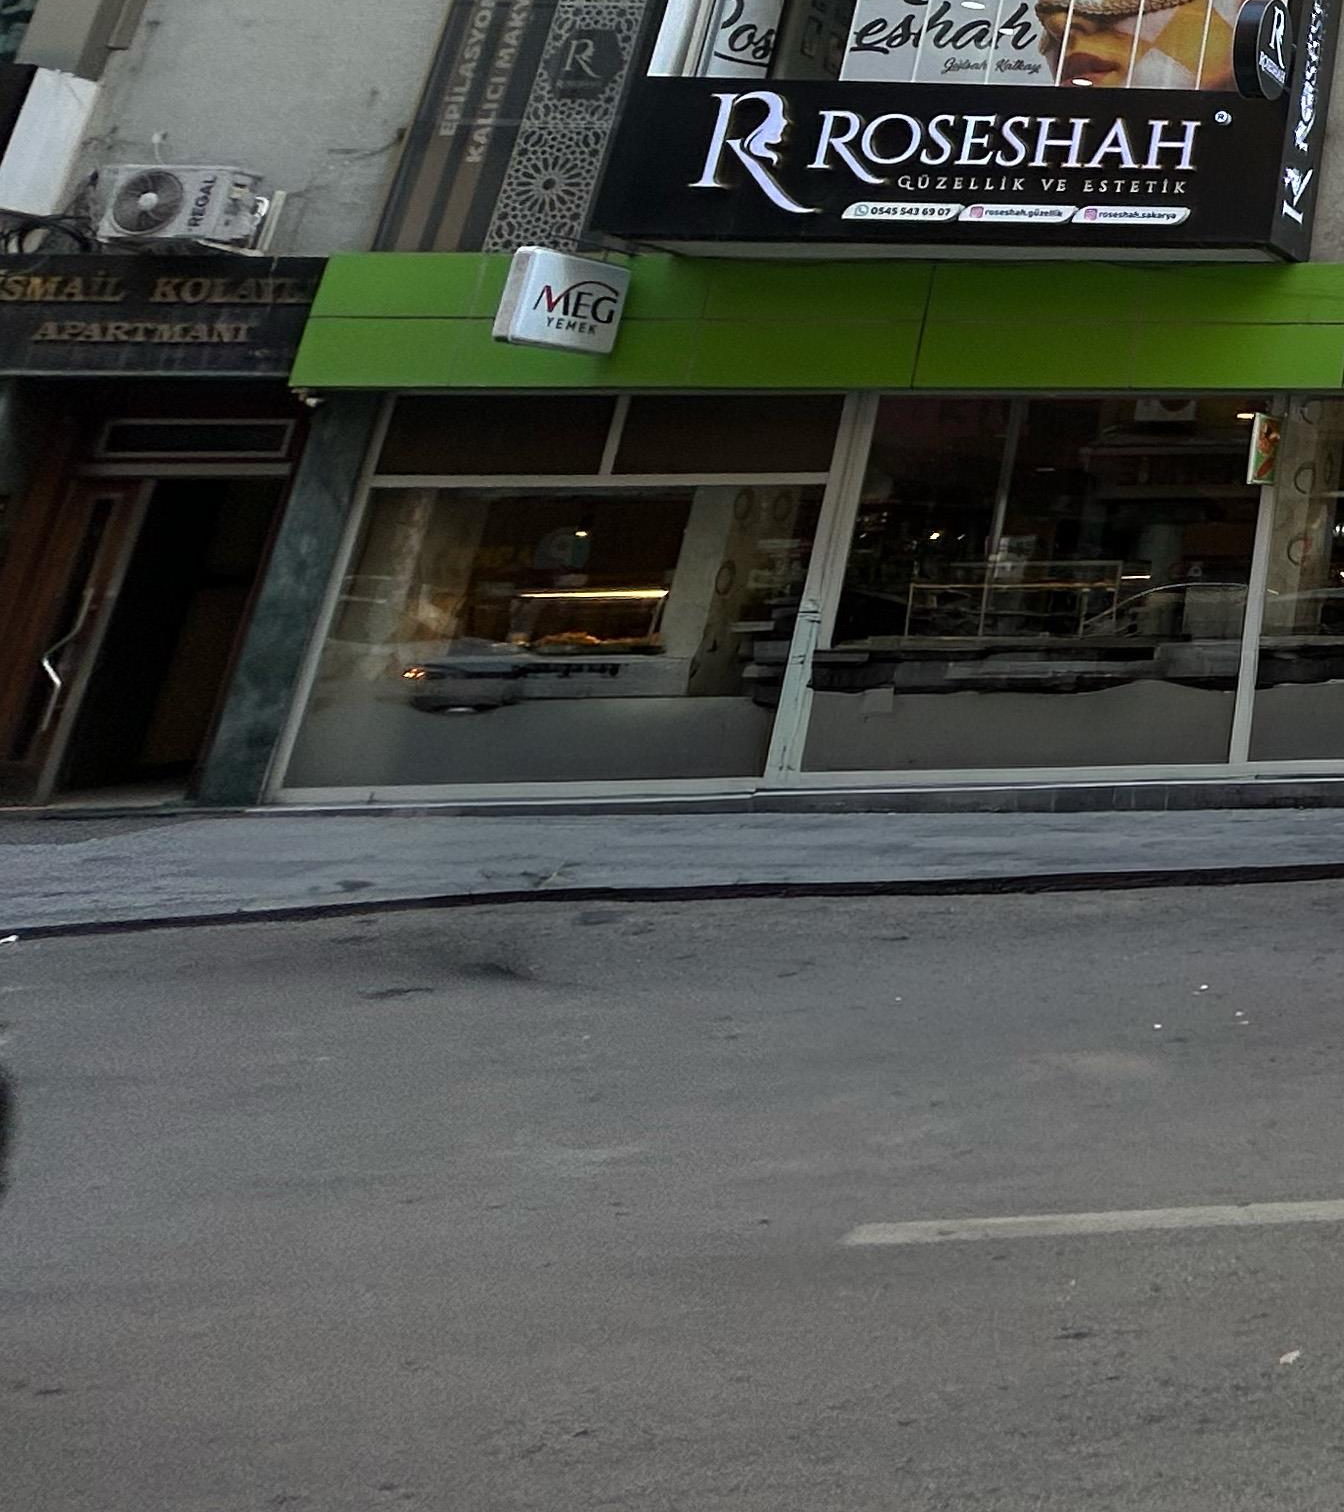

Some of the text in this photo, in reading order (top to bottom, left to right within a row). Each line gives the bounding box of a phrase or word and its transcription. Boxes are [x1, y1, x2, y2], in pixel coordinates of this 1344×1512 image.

[466, 77, 507, 164] KALICI
[806, 110, 1201, 184] ROSESHAH
[897, 174, 1187, 195] GÜZELLİK VE ESTETİK
[533, 281, 620, 324] MEG
[32, 320, 260, 343] APARTMANI
[546, 316, 598, 335] YEMEK
